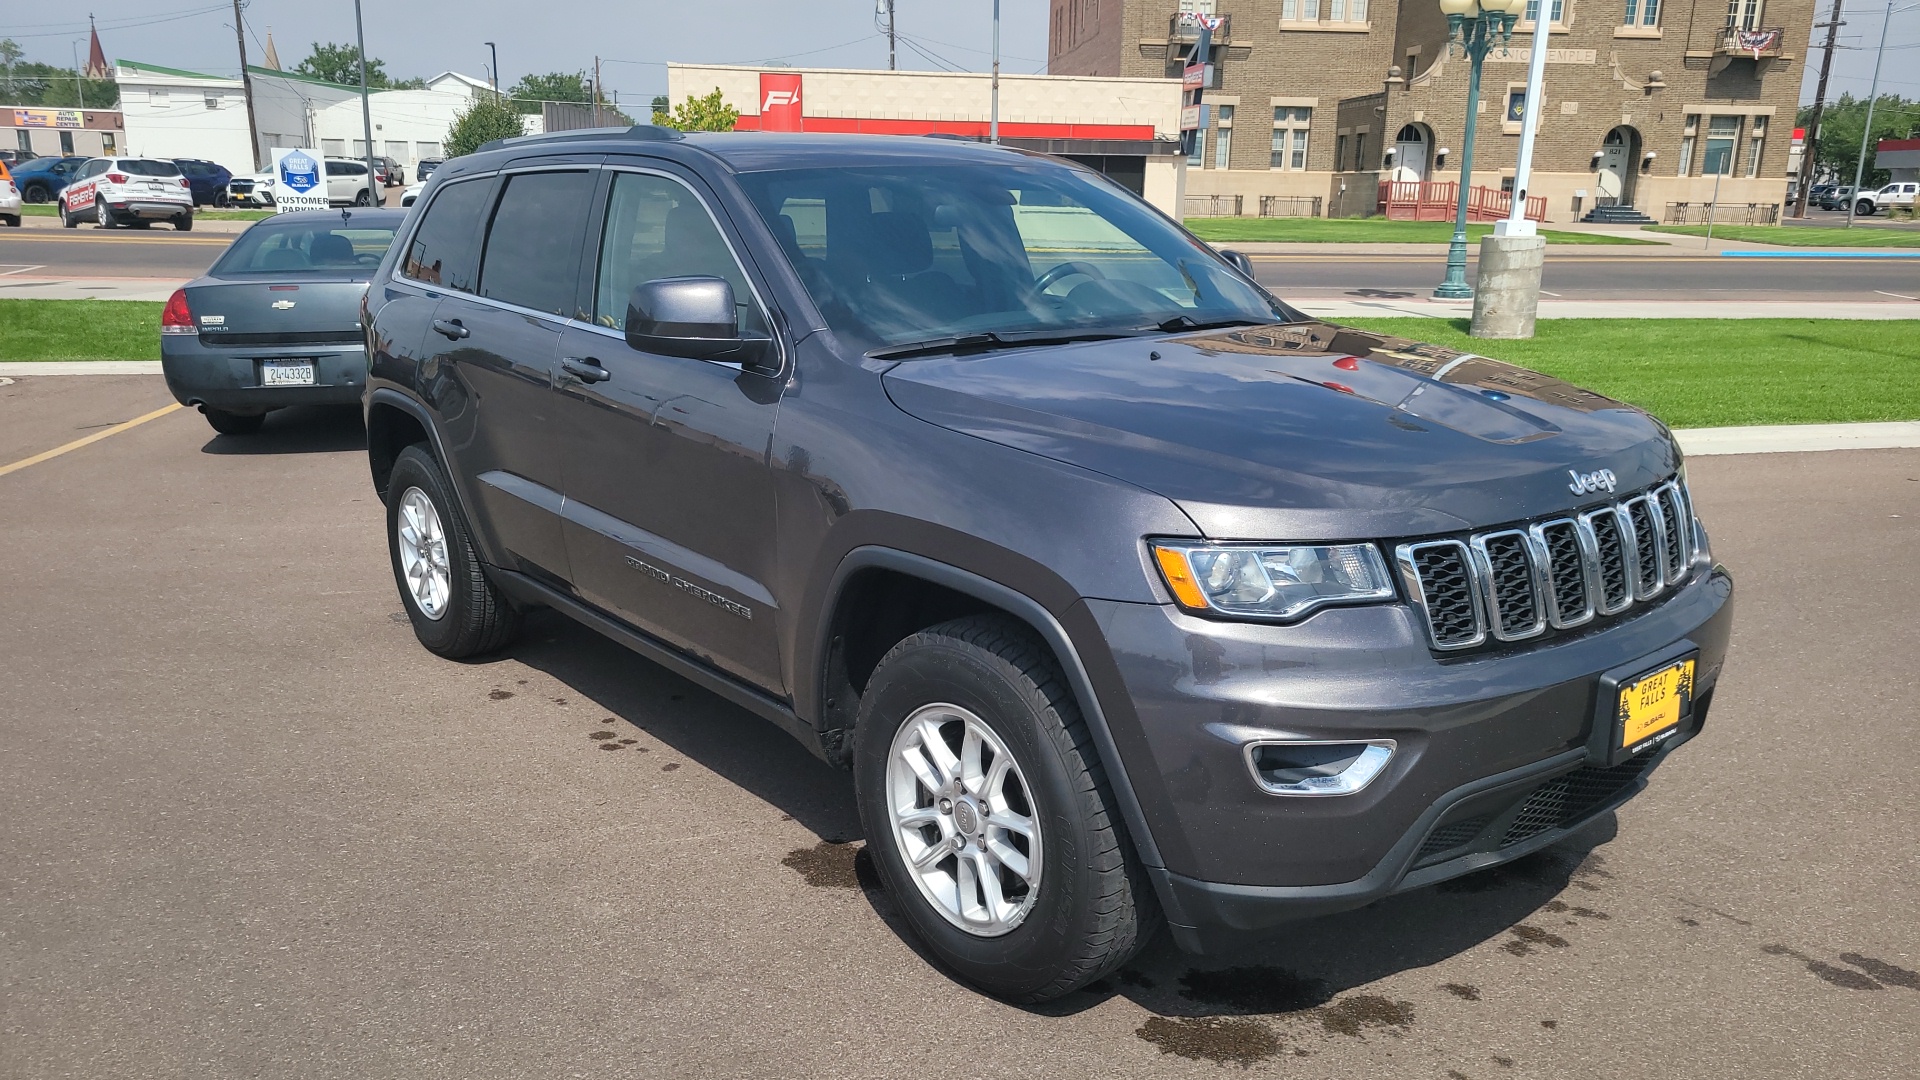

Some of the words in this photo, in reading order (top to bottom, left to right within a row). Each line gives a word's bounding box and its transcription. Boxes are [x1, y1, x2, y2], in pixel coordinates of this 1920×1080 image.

[1546, 50, 1593, 62] EMPLE
[276, 196, 329, 204] CUSTOMER
[1568, 468, 1617, 496] Jeep
[625, 555, 670, 583] GRAND
[672, 576, 751, 620] CHEROKEE
[1641, 673, 1668, 695] GREAT
[1640, 687, 1666, 710] FALLS
[1644, 712, 1666, 728] SUBARU
